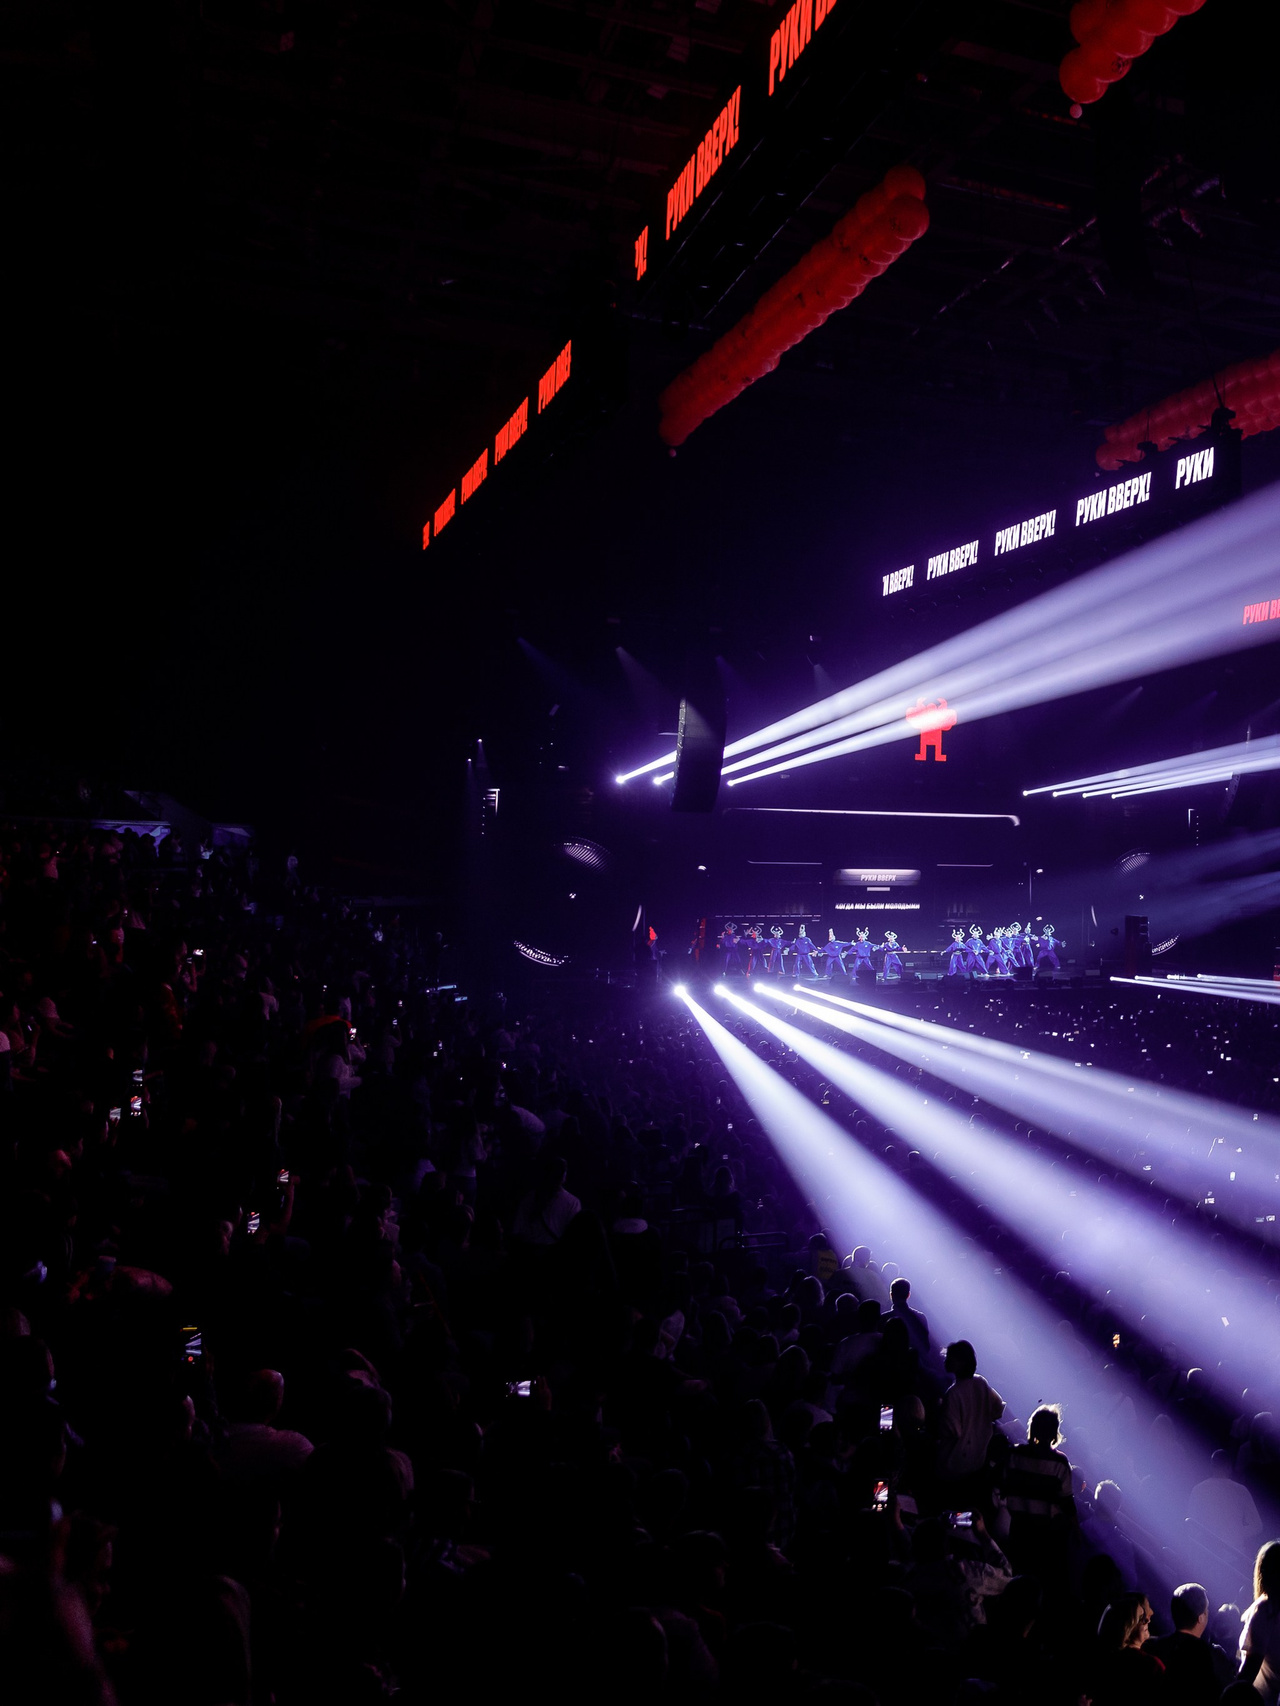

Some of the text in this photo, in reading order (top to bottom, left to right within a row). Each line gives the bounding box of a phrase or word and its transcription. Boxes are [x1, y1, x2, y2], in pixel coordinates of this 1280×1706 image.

[769, 0, 812, 96] РУКИ
[666, 85, 741, 240] РУКИ ВВЕРХ!
[1175, 447, 1214, 490] РУКИ
[1075, 472, 1152, 527] РУКИ ВВЕРХ!
[994, 510, 1057, 557] РУКИ ВВЕРХ!
[888, 565, 915, 594] ВВЕРХ!
[926, 540, 979, 581] РУКИ ВВЕРХ!
[1242, 600, 1270, 625] РУКИ
